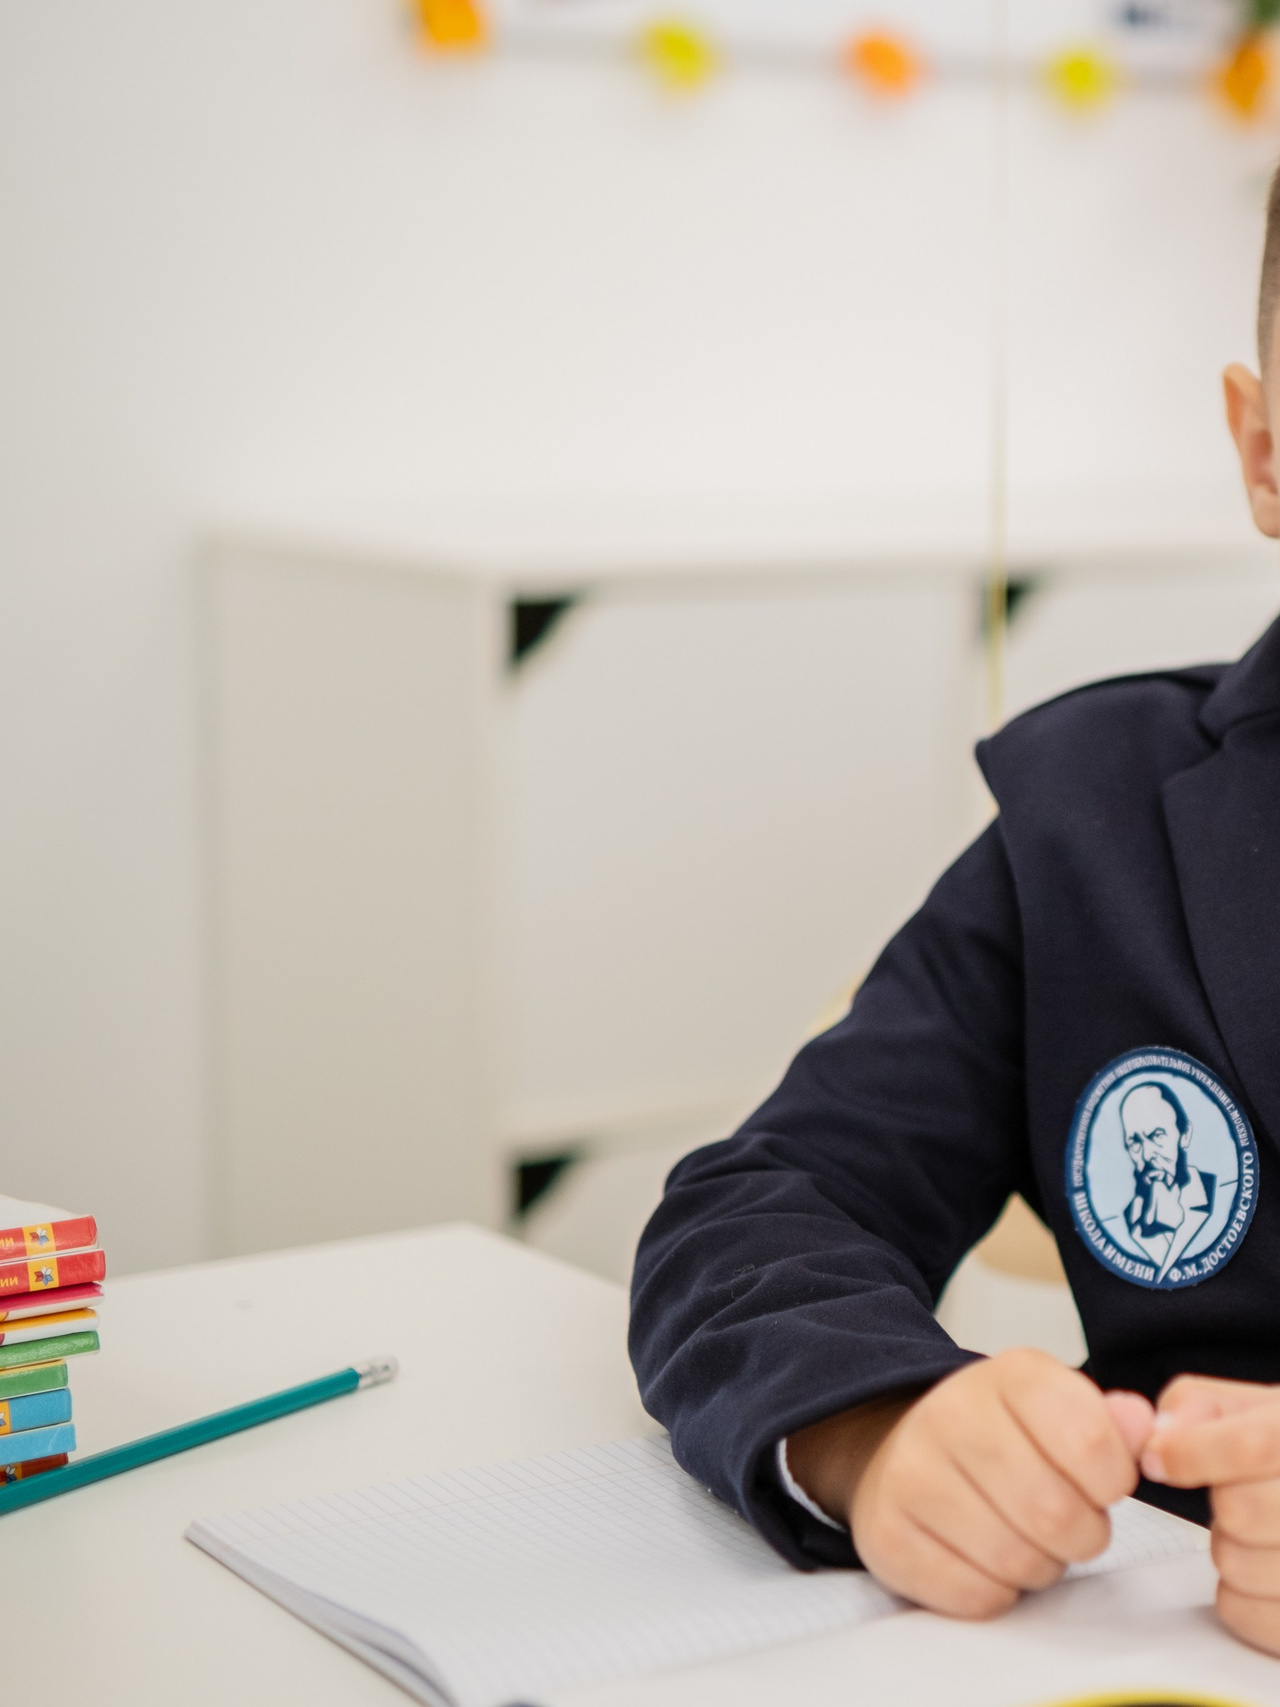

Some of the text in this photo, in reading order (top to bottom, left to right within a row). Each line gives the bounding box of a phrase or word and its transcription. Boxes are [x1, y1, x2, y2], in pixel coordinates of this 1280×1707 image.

[1191, 1066, 1231, 1106] УЧРЕЖДЕНИЕ
[1074, 1192, 1107, 1250] ШКОЛА
[1102, 1244, 1156, 1282] ИМЕНИ
